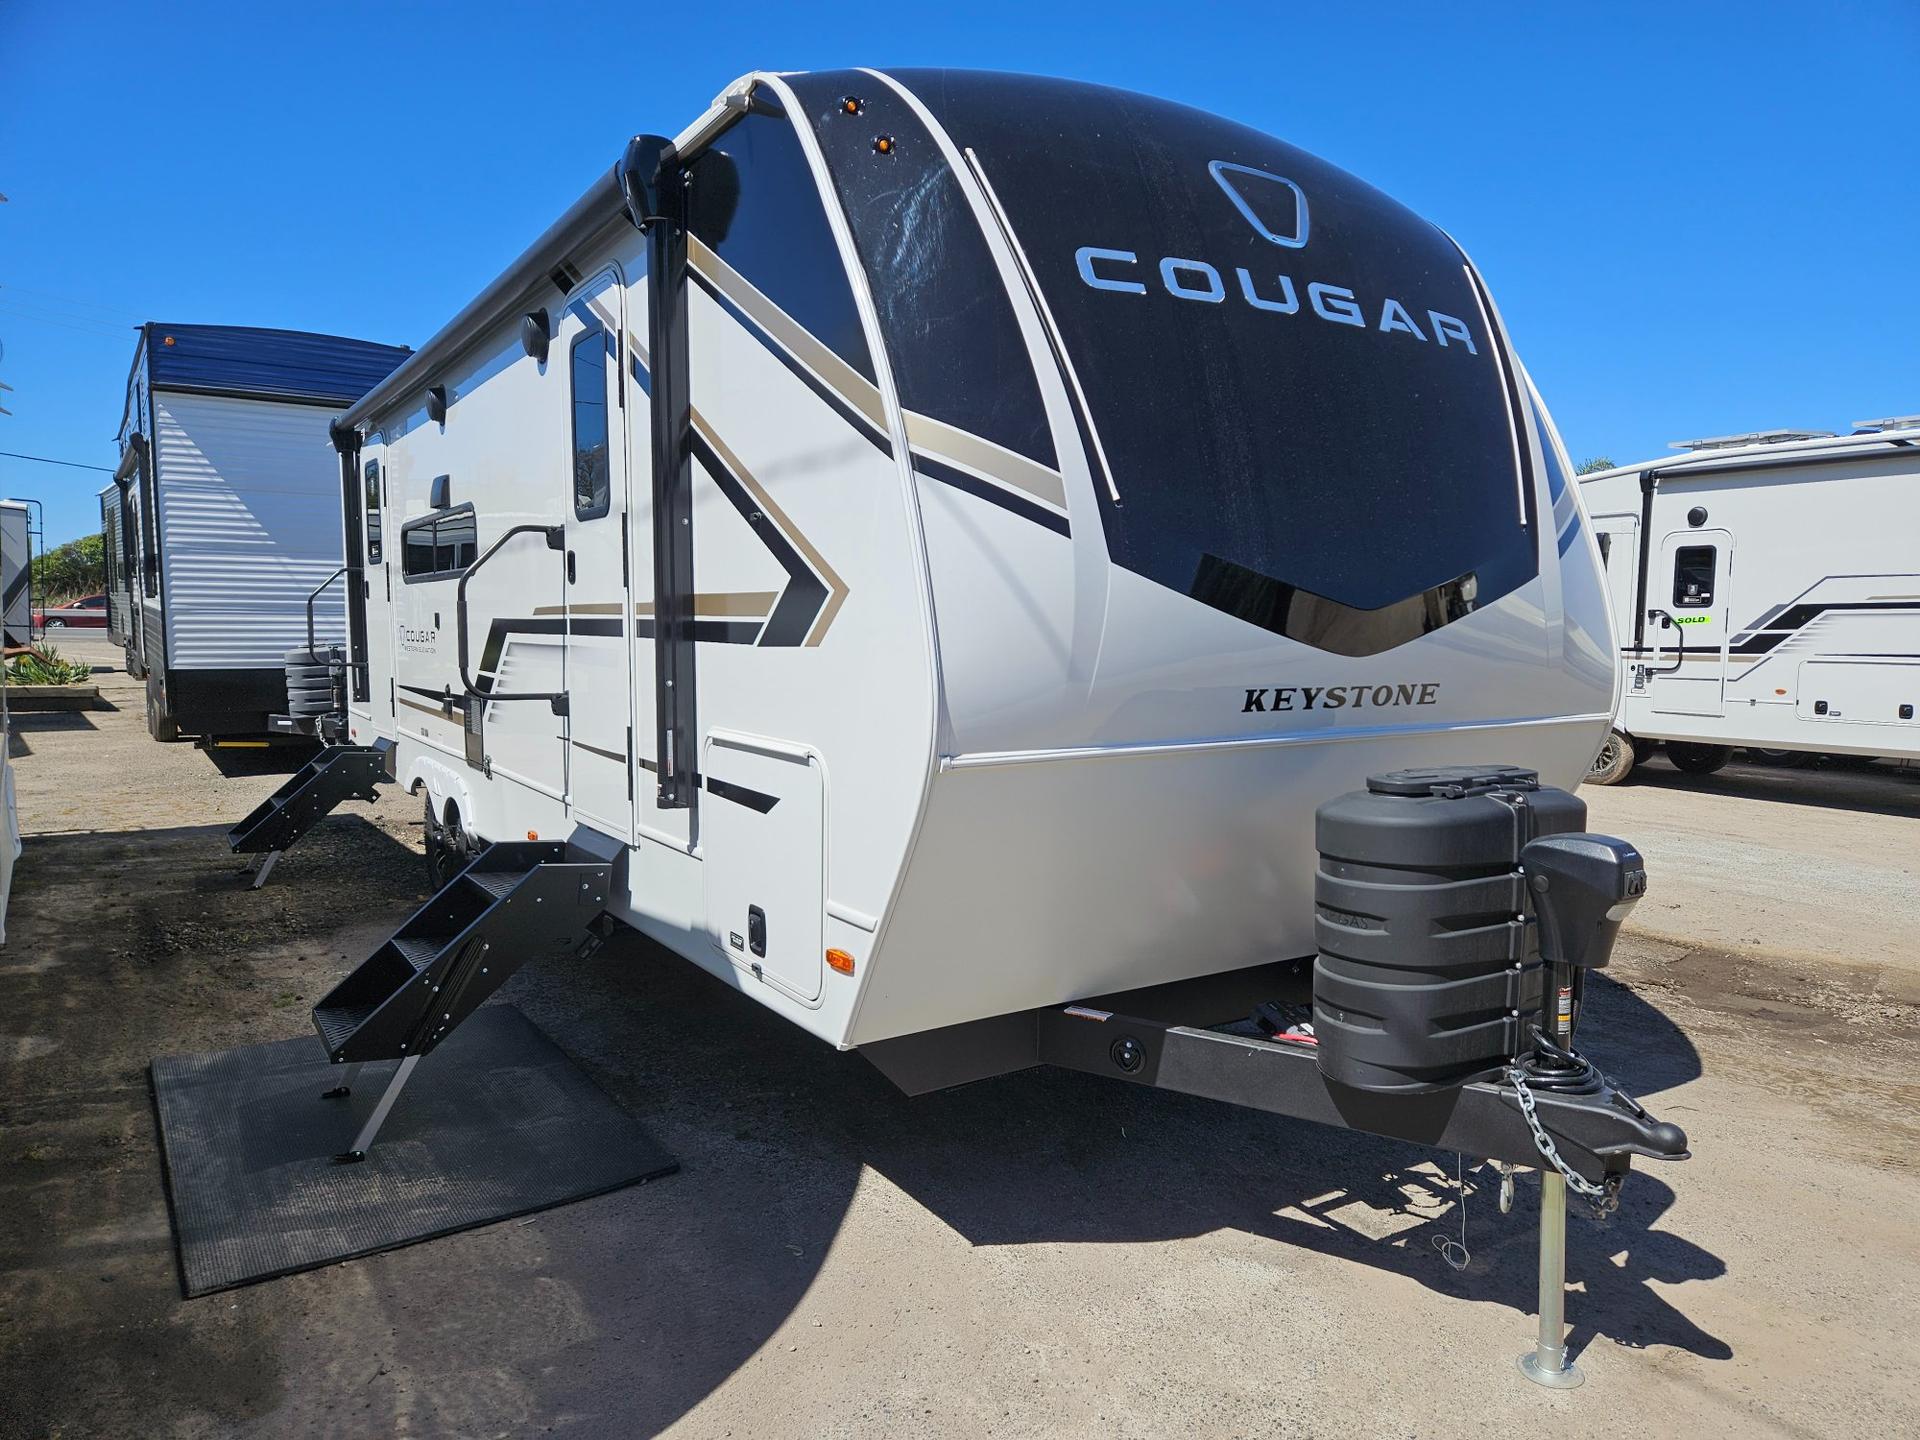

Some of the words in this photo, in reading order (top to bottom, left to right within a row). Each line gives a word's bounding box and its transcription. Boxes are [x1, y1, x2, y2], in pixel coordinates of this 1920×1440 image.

[1075, 246, 1478, 355] COUGAR
[1677, 616, 1706, 624] SOLD
[406, 630, 436, 643] COUGAR
[1241, 683, 1440, 713] KEYSTONE
